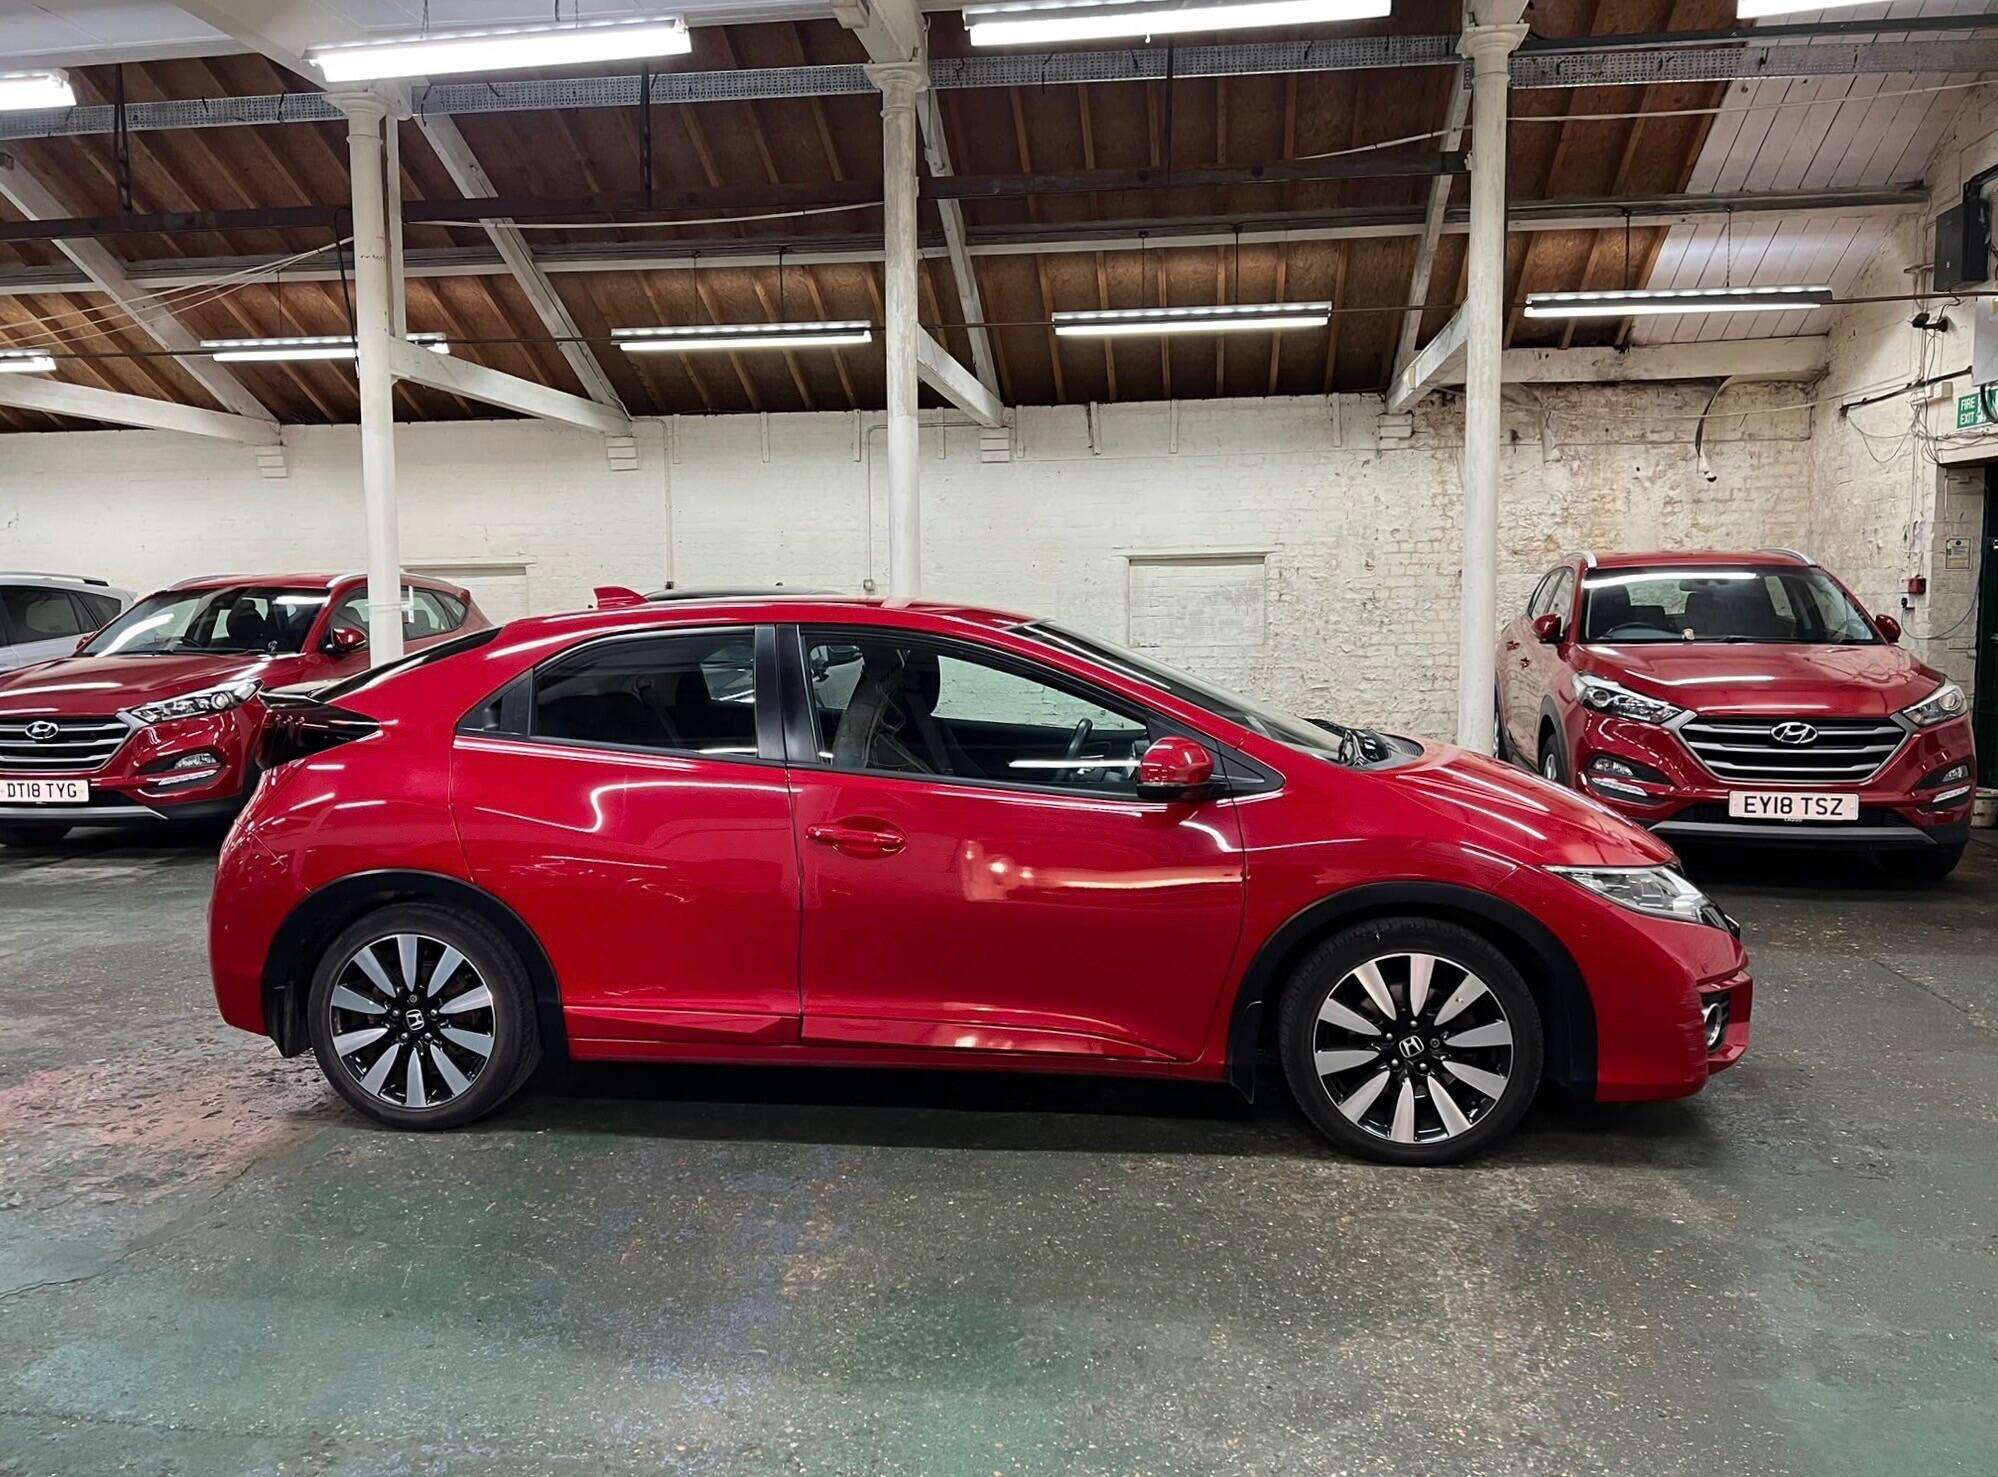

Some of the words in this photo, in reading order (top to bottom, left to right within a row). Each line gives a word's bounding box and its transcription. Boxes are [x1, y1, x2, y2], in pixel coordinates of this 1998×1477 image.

[1960, 397, 1976, 411] FIRE
[1960, 411, 1976, 425] EXIT
[7, 783, 40, 798] DT18
[46, 783, 77, 798] TYG
[1744, 796, 1793, 814] EY18
[1801, 797, 1843, 816] TSZ
